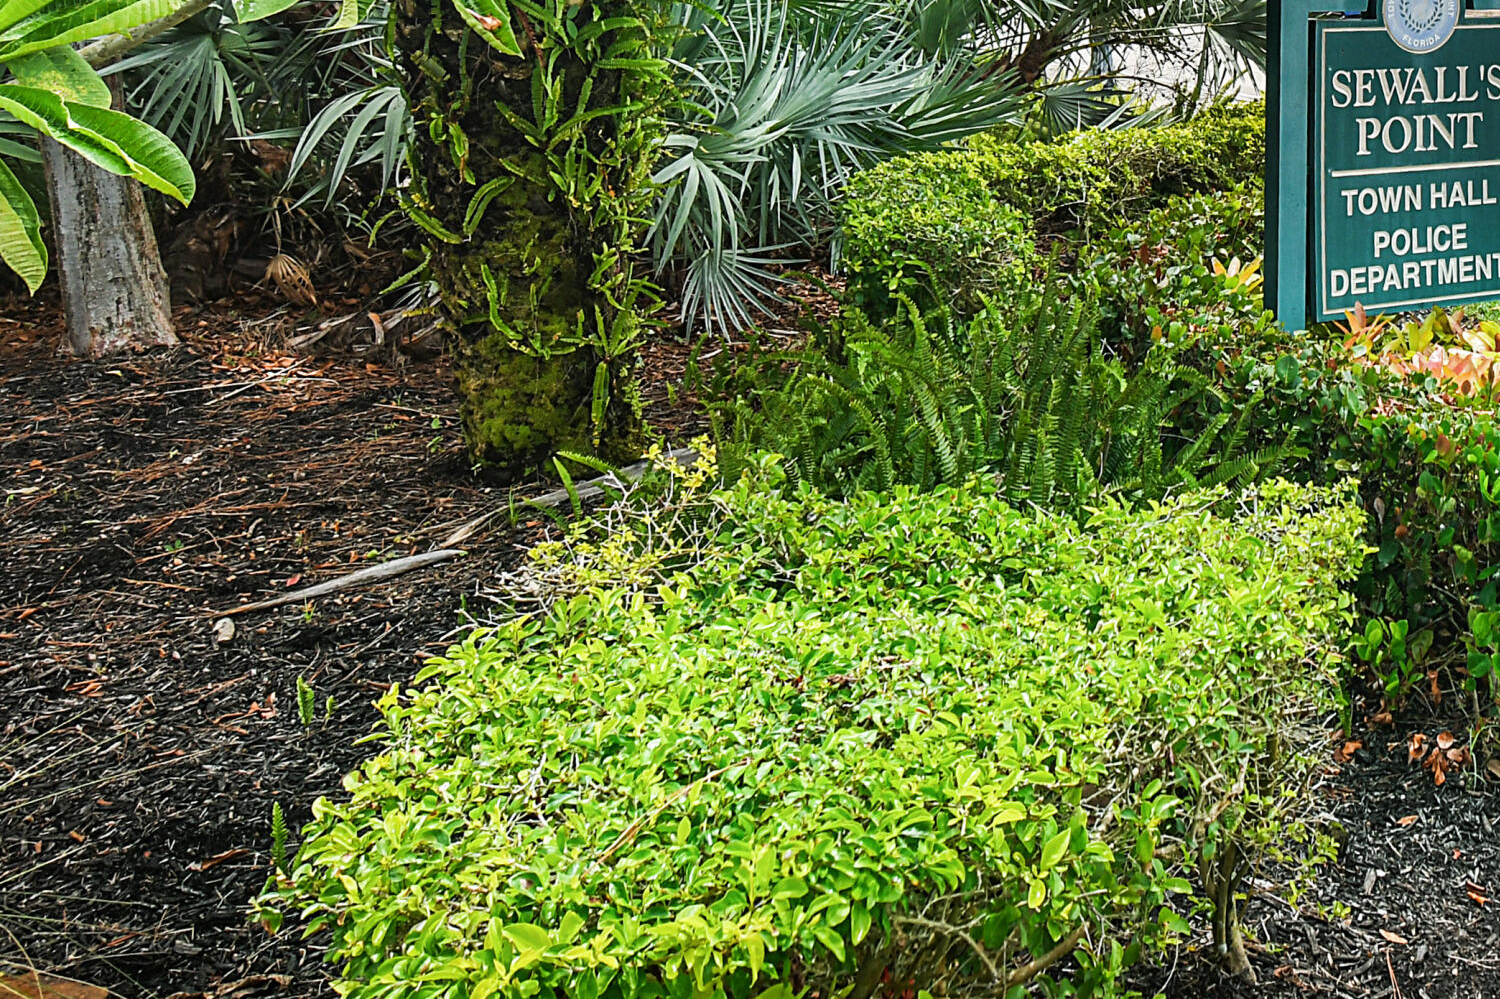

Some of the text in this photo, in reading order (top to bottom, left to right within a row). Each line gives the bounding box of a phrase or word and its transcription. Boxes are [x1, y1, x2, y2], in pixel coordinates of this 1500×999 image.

[1402, 33, 1441, 47] FLORIDA
[1355, 112, 1484, 156] POINT
[1341, 179, 1497, 216] TOWN HALL
[1373, 223, 1468, 258] POLICE
